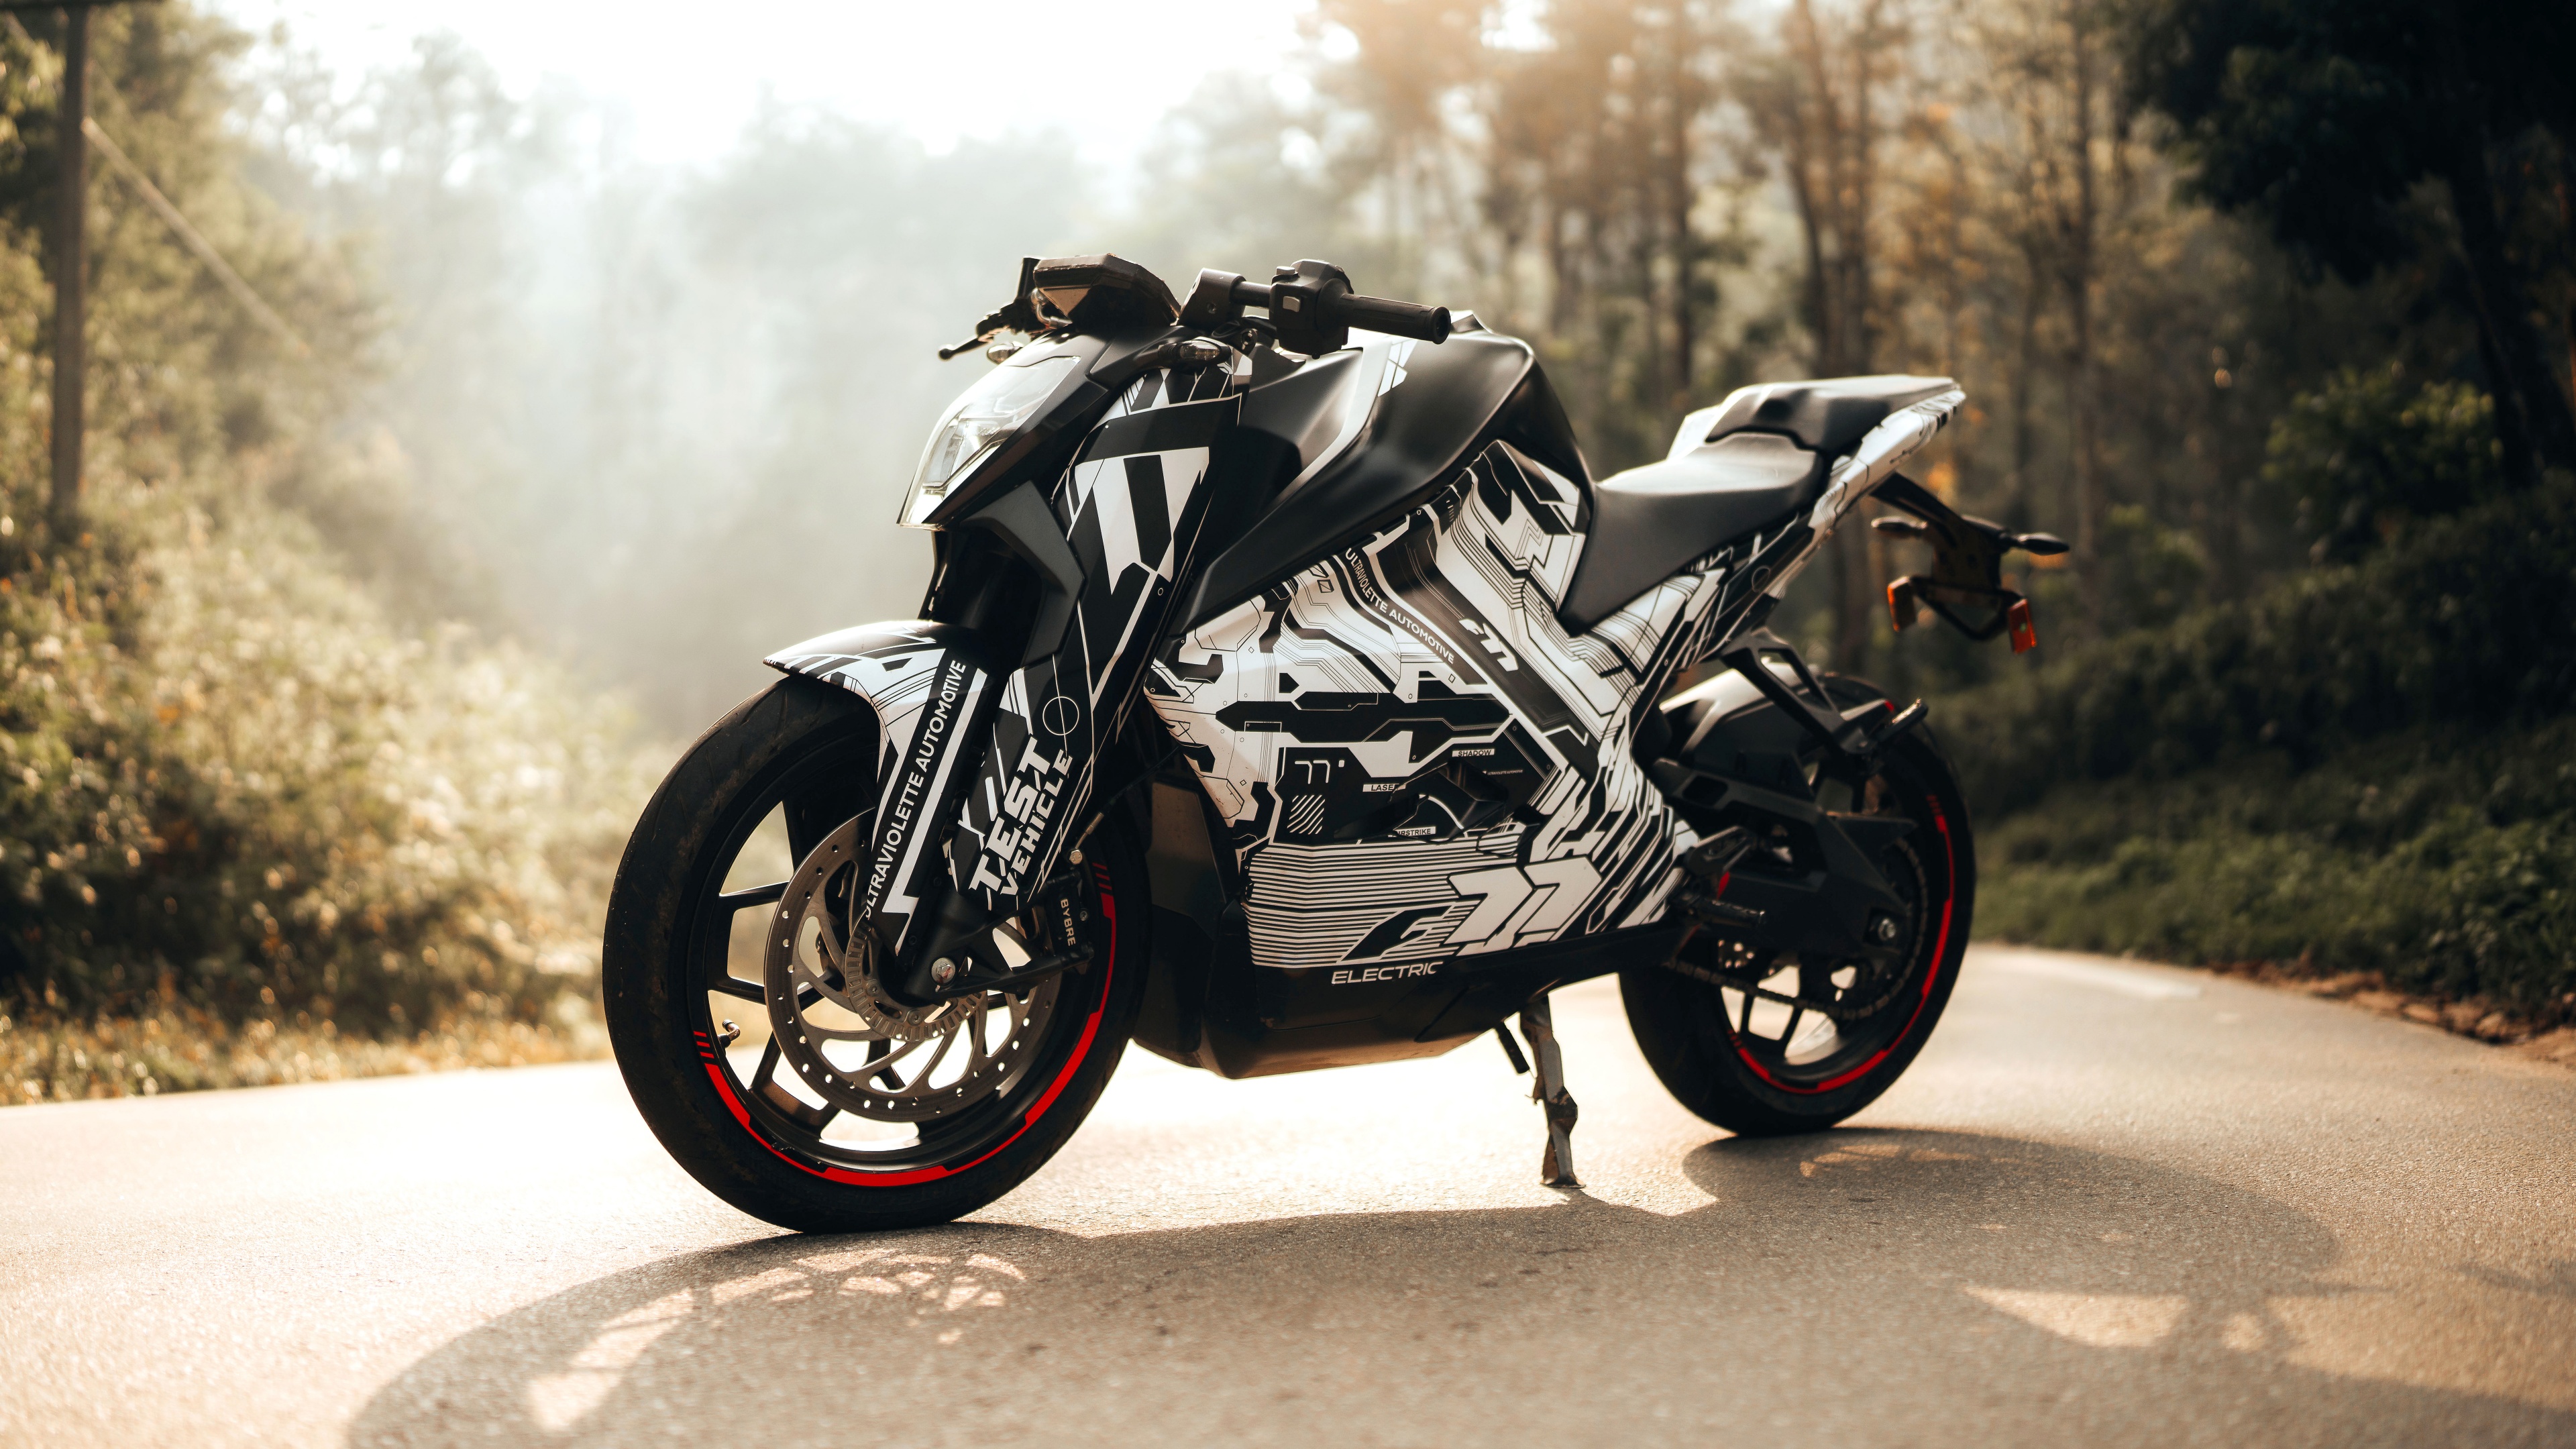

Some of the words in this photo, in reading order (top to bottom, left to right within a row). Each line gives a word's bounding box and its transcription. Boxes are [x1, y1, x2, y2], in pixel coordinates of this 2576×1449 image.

[1346, 547, 1388, 611] ULTRAVIOLETTE
[1389, 608, 1455, 664] AUTOMOTIVE
[865, 771, 924, 920] ULTRAVIOLETTE
[915, 659, 966, 773] AUTOMOTIVE
[1458, 749, 1491, 757] SHADOW
[968, 736, 1051, 892] TEST
[1000, 749, 1073, 896] VEHICLE
[1396, 828, 1432, 837] IRSTRIKE
[1061, 899, 1076, 947] BYBRE
[1331, 961, 1444, 985] ELECTRIC
